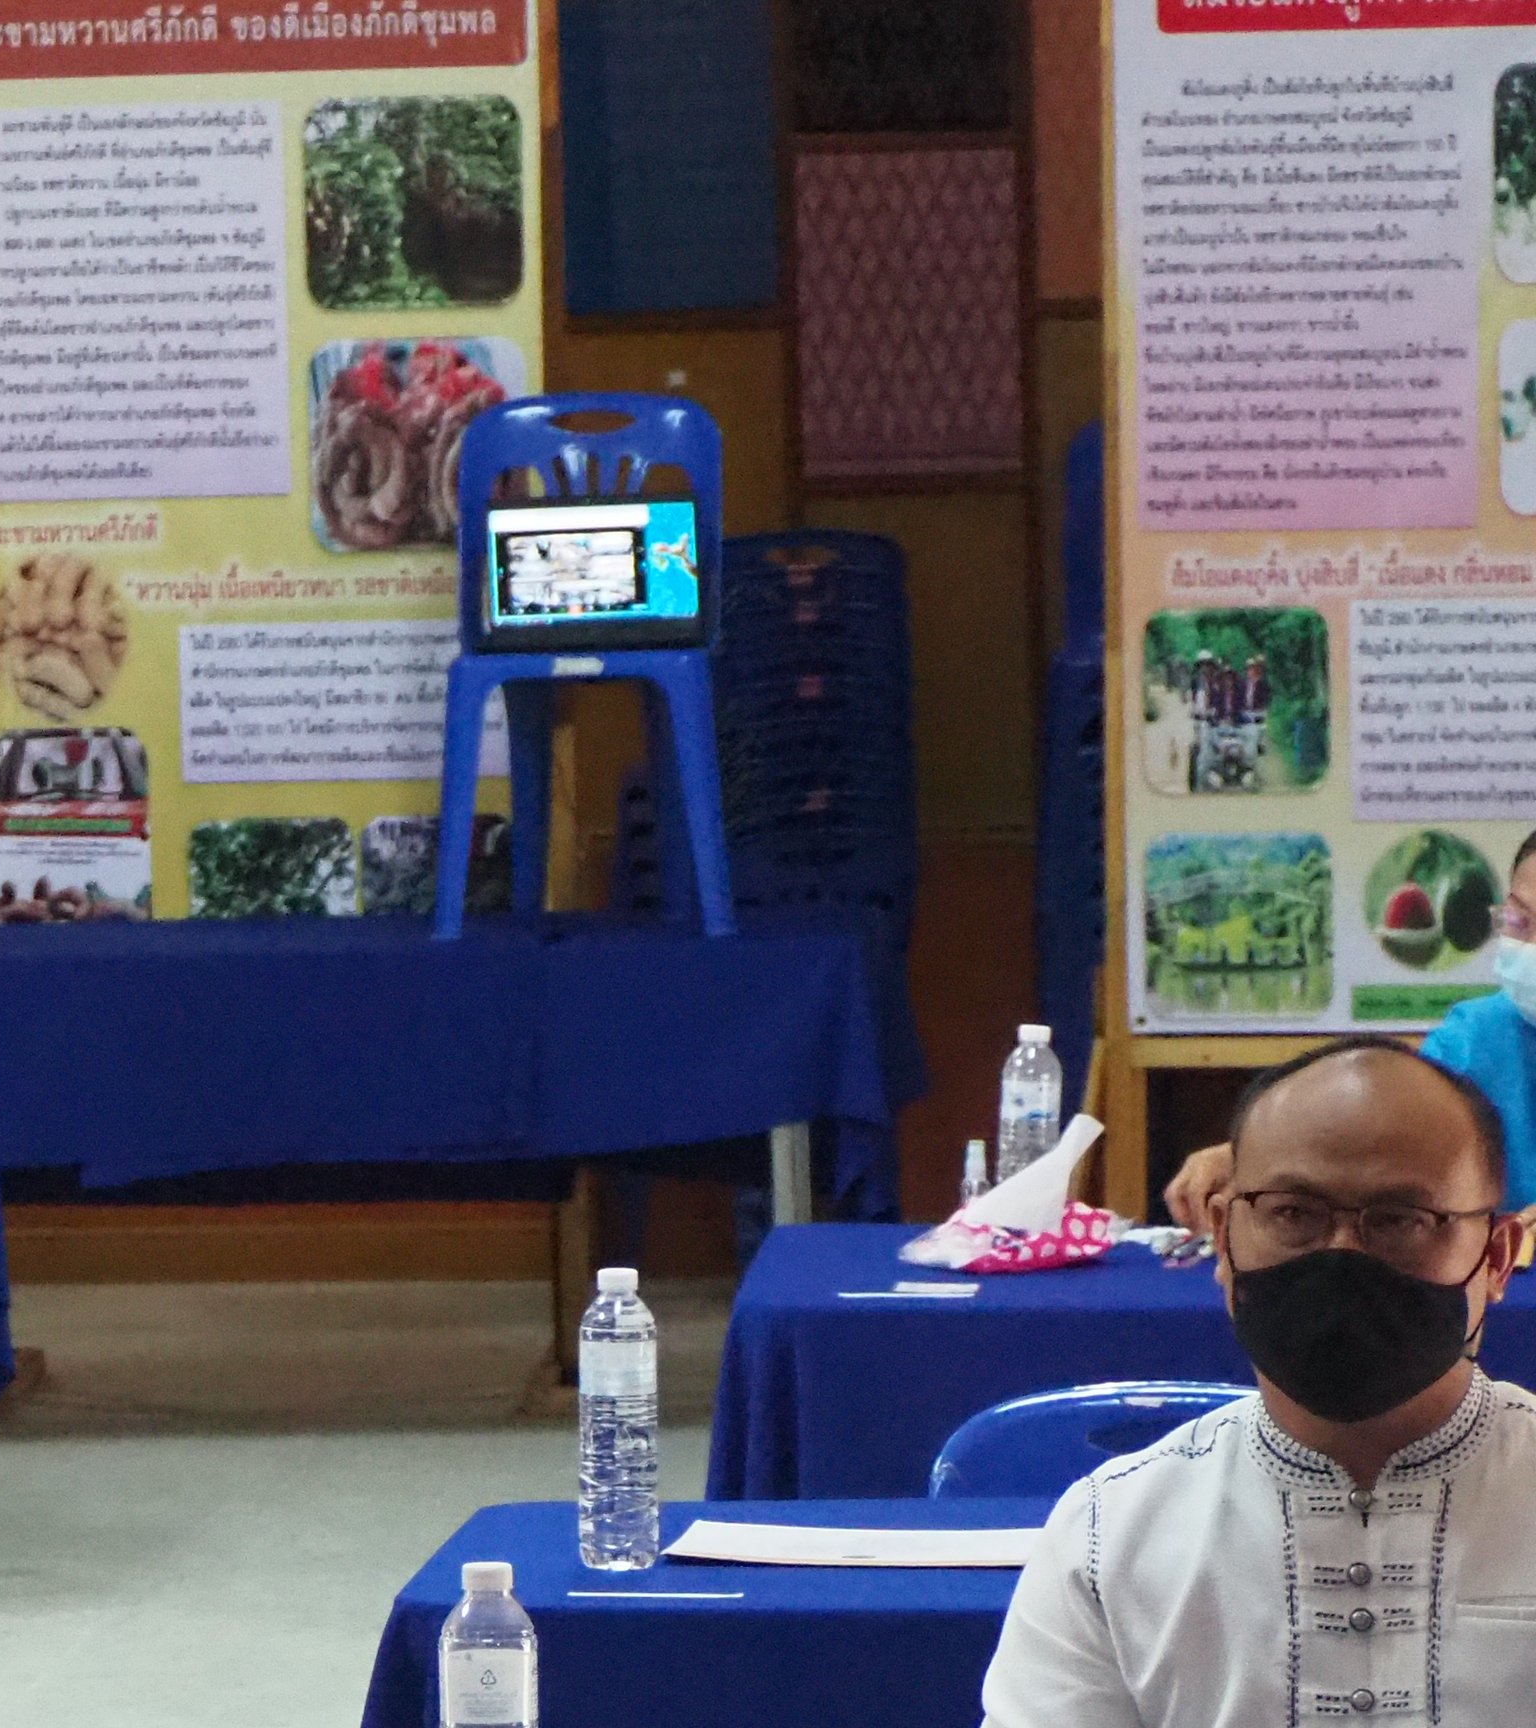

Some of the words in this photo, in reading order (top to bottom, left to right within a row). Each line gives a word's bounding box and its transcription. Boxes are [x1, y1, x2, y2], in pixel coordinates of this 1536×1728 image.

[229, 2, 497, 48] ของดีเมืองภักดีชุมพล
